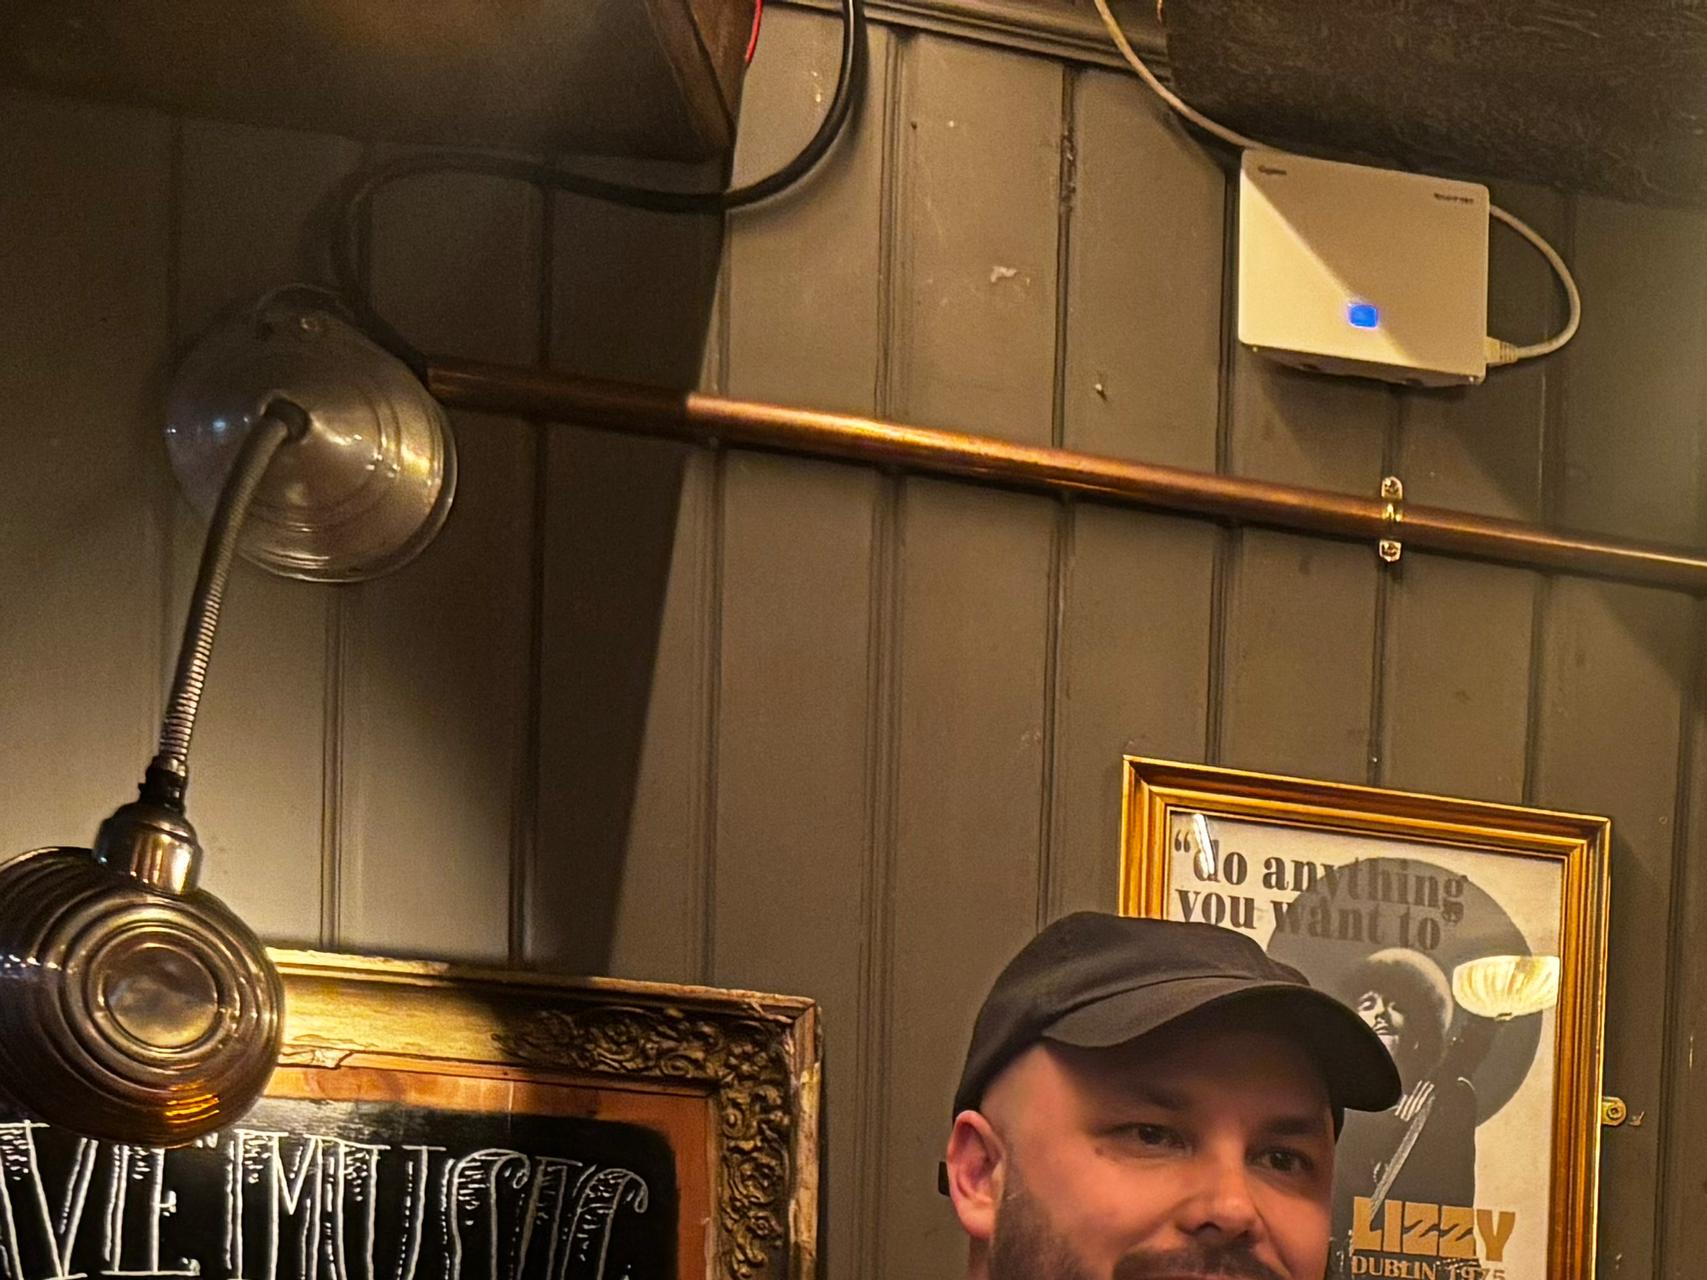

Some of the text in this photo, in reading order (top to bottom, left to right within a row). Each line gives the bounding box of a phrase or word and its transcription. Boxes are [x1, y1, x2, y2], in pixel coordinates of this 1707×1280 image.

[1175, 889, 1256, 929] you
[1271, 899, 1384, 944] want
[1263, 857, 1469, 924] anything
[1352, 1196, 1516, 1262] LIZZY
[1352, 1256, 1438, 1280] DUBLIN
